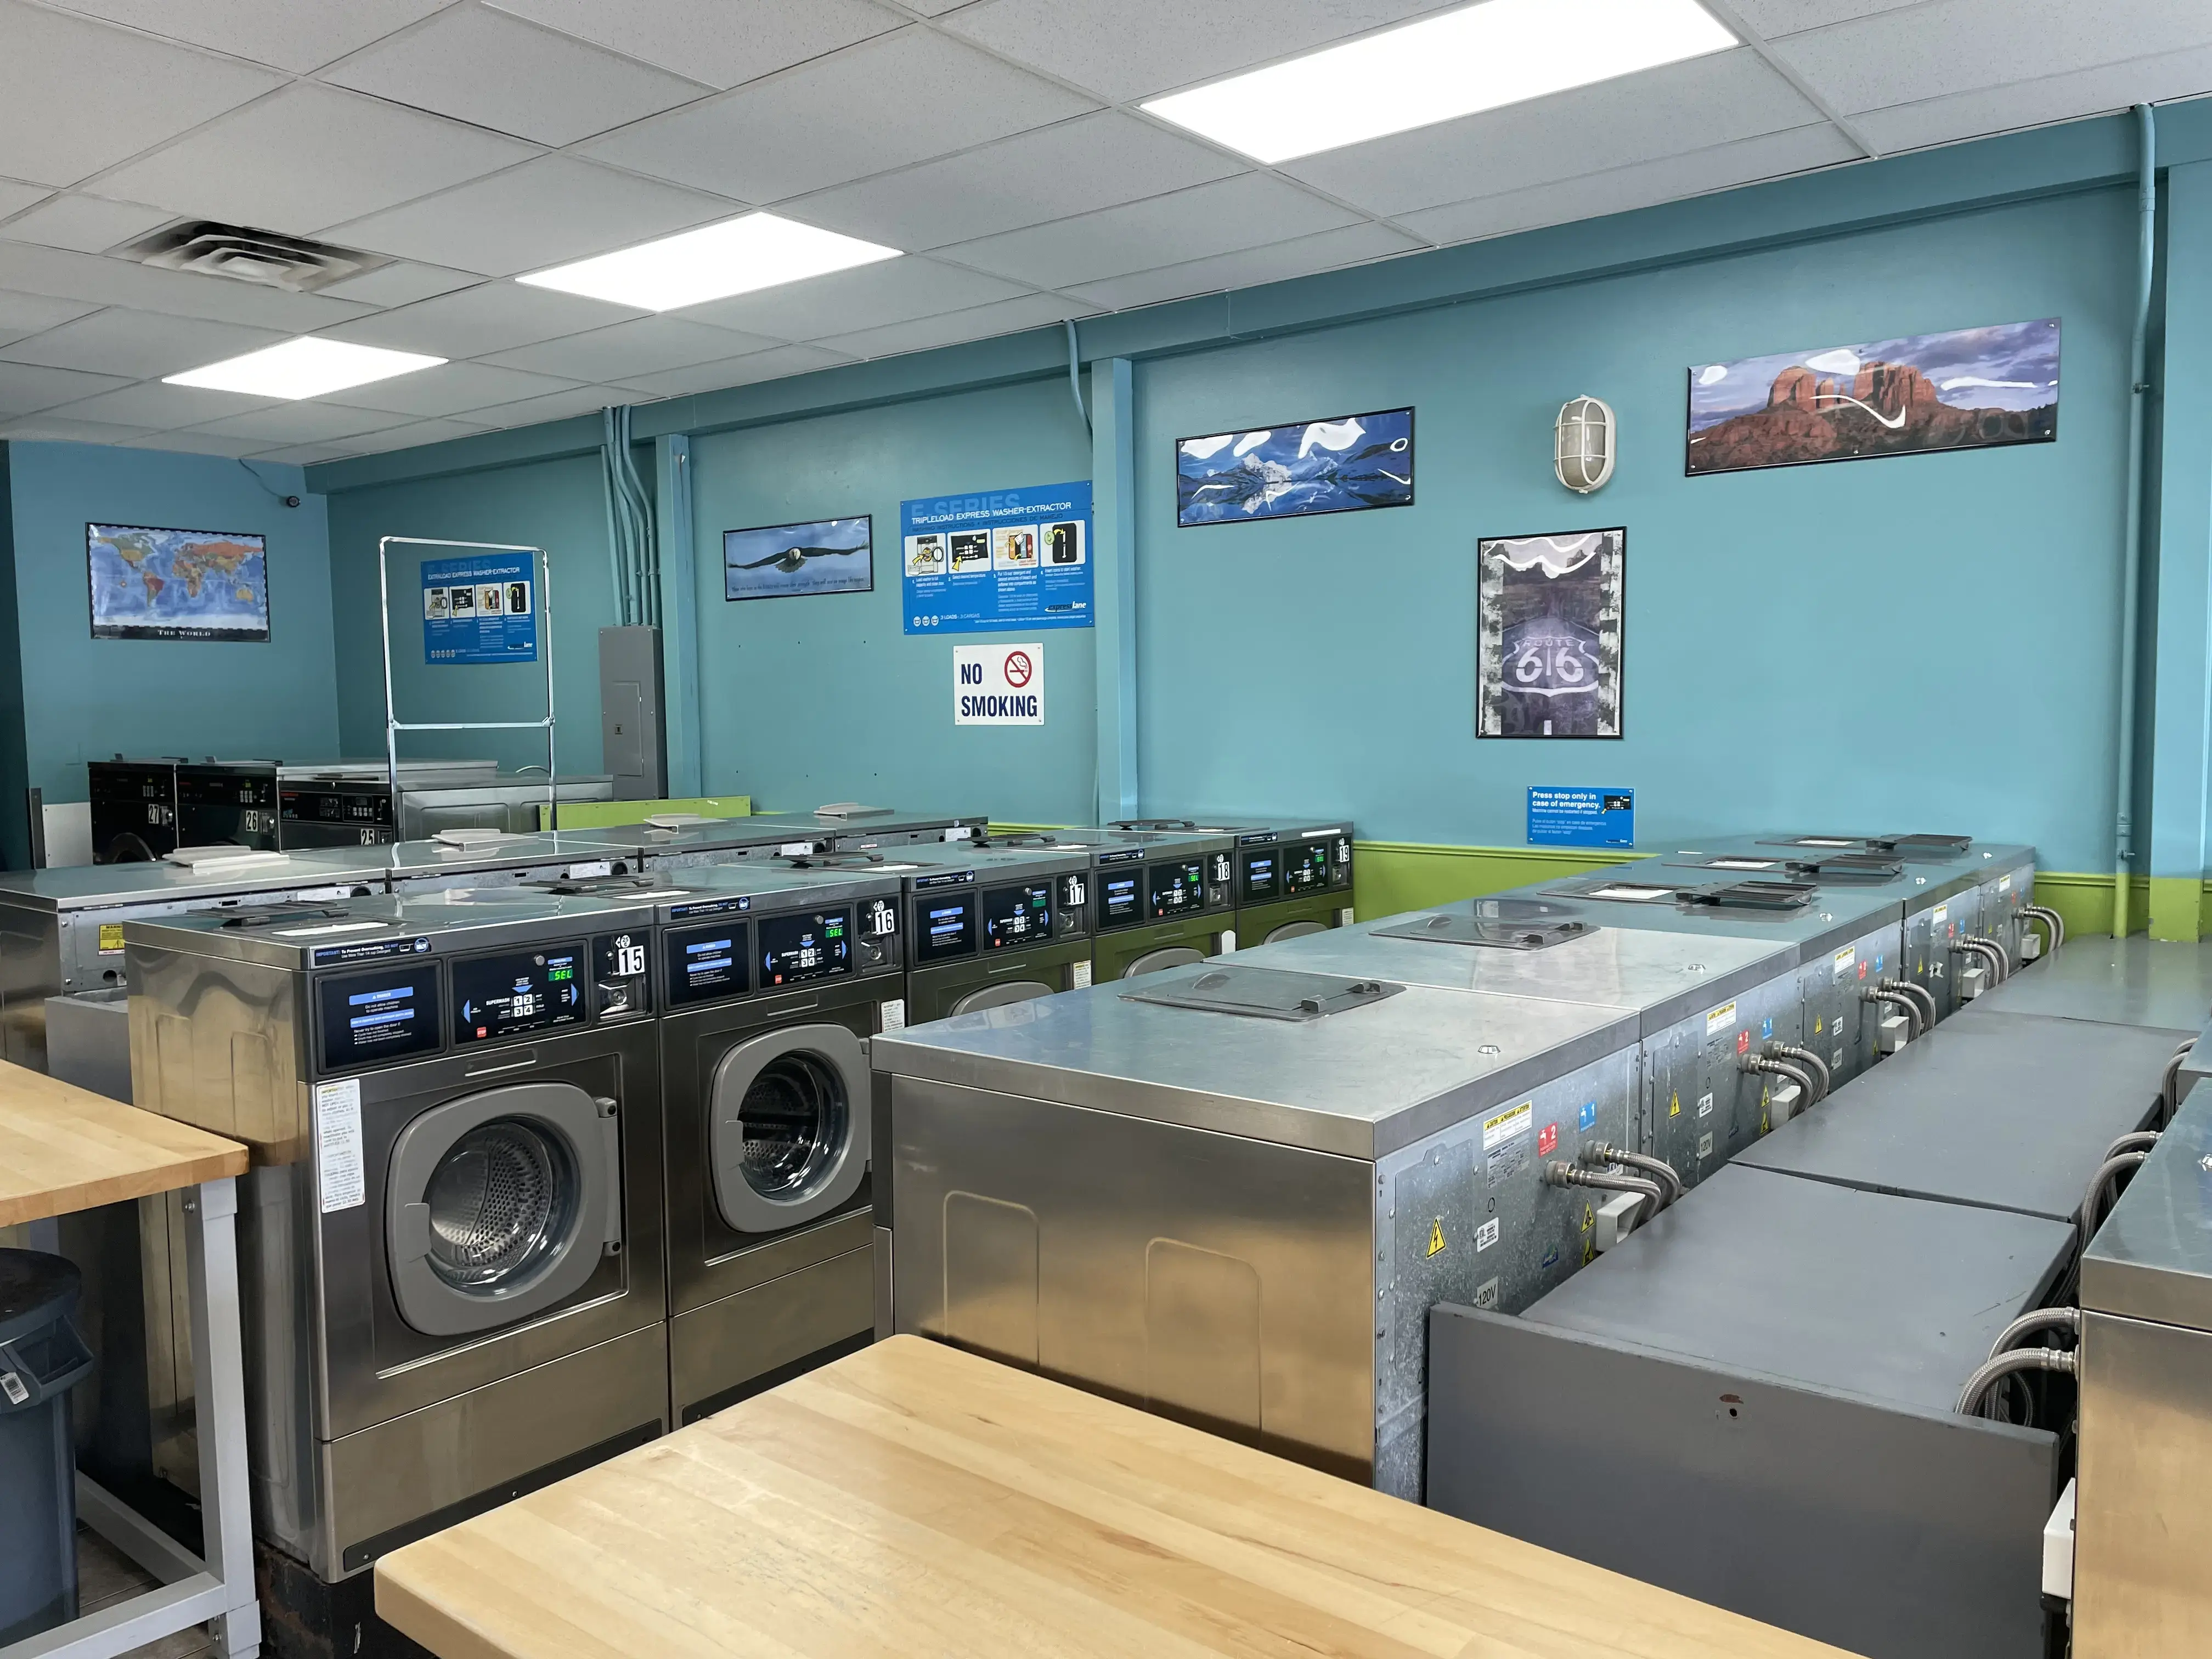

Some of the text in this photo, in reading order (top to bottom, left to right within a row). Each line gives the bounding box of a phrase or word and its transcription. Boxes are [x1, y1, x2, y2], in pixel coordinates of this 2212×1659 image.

[912, 503, 1071, 525] TRIPLELOAD EXPRESS WASHER-EXTRACTOR
[473, 567, 520, 576] WASHER-EXTRACTOR
[961, 663, 982, 684] NO
[961, 696, 1037, 716] SMOKING
[1572, 793, 1587, 801] only
[149, 805, 159, 823] 27
[247, 811, 257, 831] 26
[362, 830, 374, 845] 25
[1341, 847, 1348, 861] 19
[1219, 863, 1228, 879] 18
[1072, 885, 1082, 902] 17
[878, 912, 892, 932] 16
[830, 928, 842, 937] SEL
[622, 948, 642, 973] 15
[555, 970, 571, 980] SEL
[1745, 1031, 1748, 1042] 2
[1592, 1104, 1594, 1116] 1
[1551, 1125, 1556, 1140] 2
[1701, 1137, 1711, 1152] 120V
[1479, 1284, 1496, 1306] 120V
